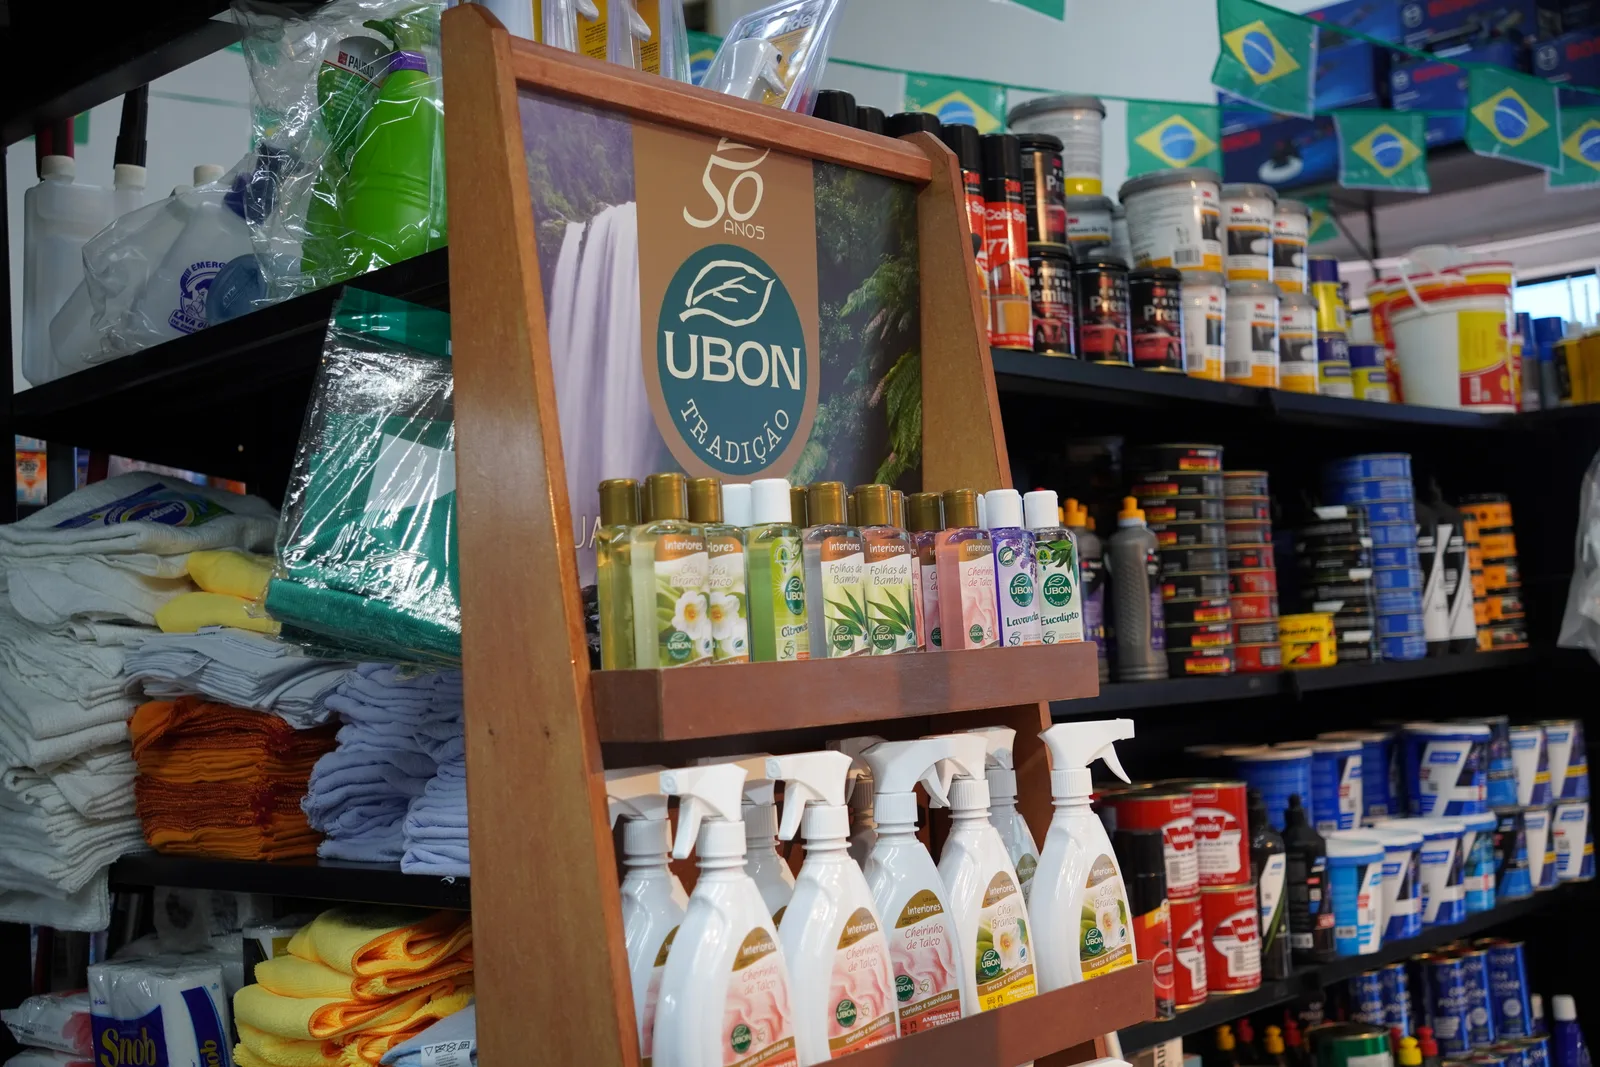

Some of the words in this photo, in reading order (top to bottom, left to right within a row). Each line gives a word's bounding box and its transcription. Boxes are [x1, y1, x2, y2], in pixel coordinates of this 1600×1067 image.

[683, 142, 770, 228] 50
[724, 219, 765, 240] ANOS
[987, 238, 1009, 255] 77
[173, 311, 195, 326] LAVA
[664, 330, 801, 390] UBON
[680, 398, 790, 465] TRADIÇÃO
[830, 563, 854, 573] Folhas
[870, 564, 897, 575] Folhas
[899, 566, 908, 574] de
[874, 576, 903, 585] Bambu
[1010, 586, 1033, 595] UBON
[1044, 586, 1072, 595] UBON
[1006, 612, 1039, 627] Lavanda
[1041, 611, 1080, 626] Eucalipto
[667, 641, 692, 650] UBON
[904, 923, 944, 939] Cheirinho
[906, 939, 917, 951] de
[920, 936, 941, 948] Talco
[1085, 936, 1103, 946] UBON
[848, 961, 858, 972] de
[860, 957, 878, 969] Talco
[981, 958, 1001, 969] UBON
[836, 1008, 857, 1020] UBON
[922, 1011, 960, 1023] AMBIENTES
[100, 1026, 157, 1067] Snob
[731, 1033, 752, 1046] UBON
